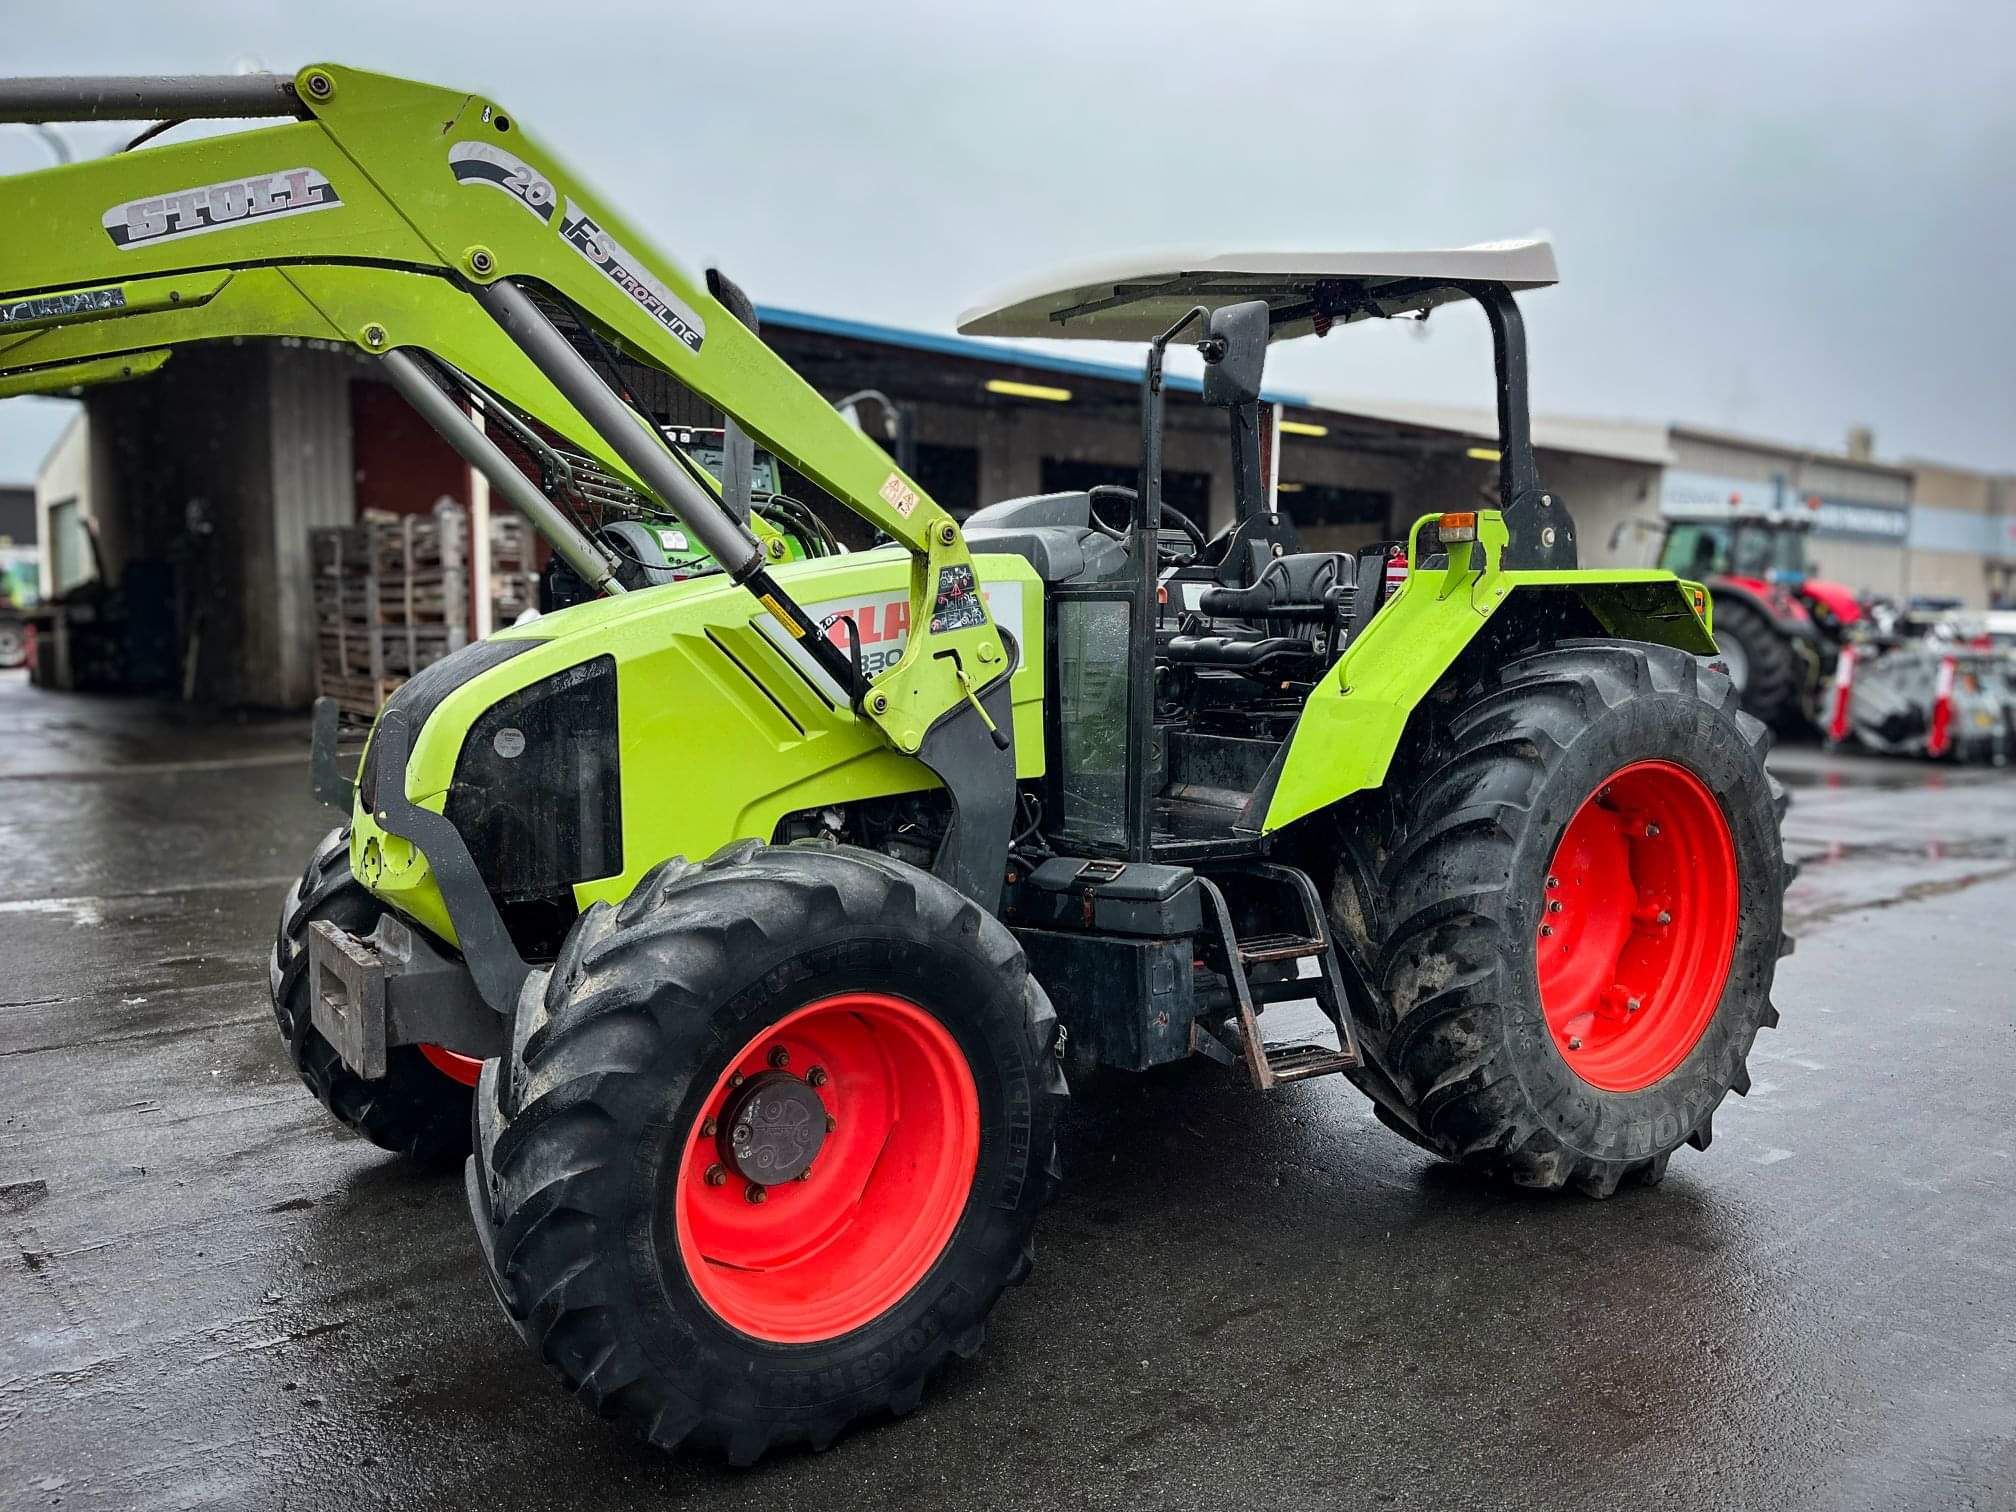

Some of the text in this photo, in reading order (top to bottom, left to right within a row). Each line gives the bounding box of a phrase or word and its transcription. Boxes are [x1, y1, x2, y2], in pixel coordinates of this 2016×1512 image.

[126, 171, 323, 240] STOLL
[502, 166, 552, 206] 20
[565, 216, 699, 346] FS PROFILINE
[826, 601, 911, 649] CLA
